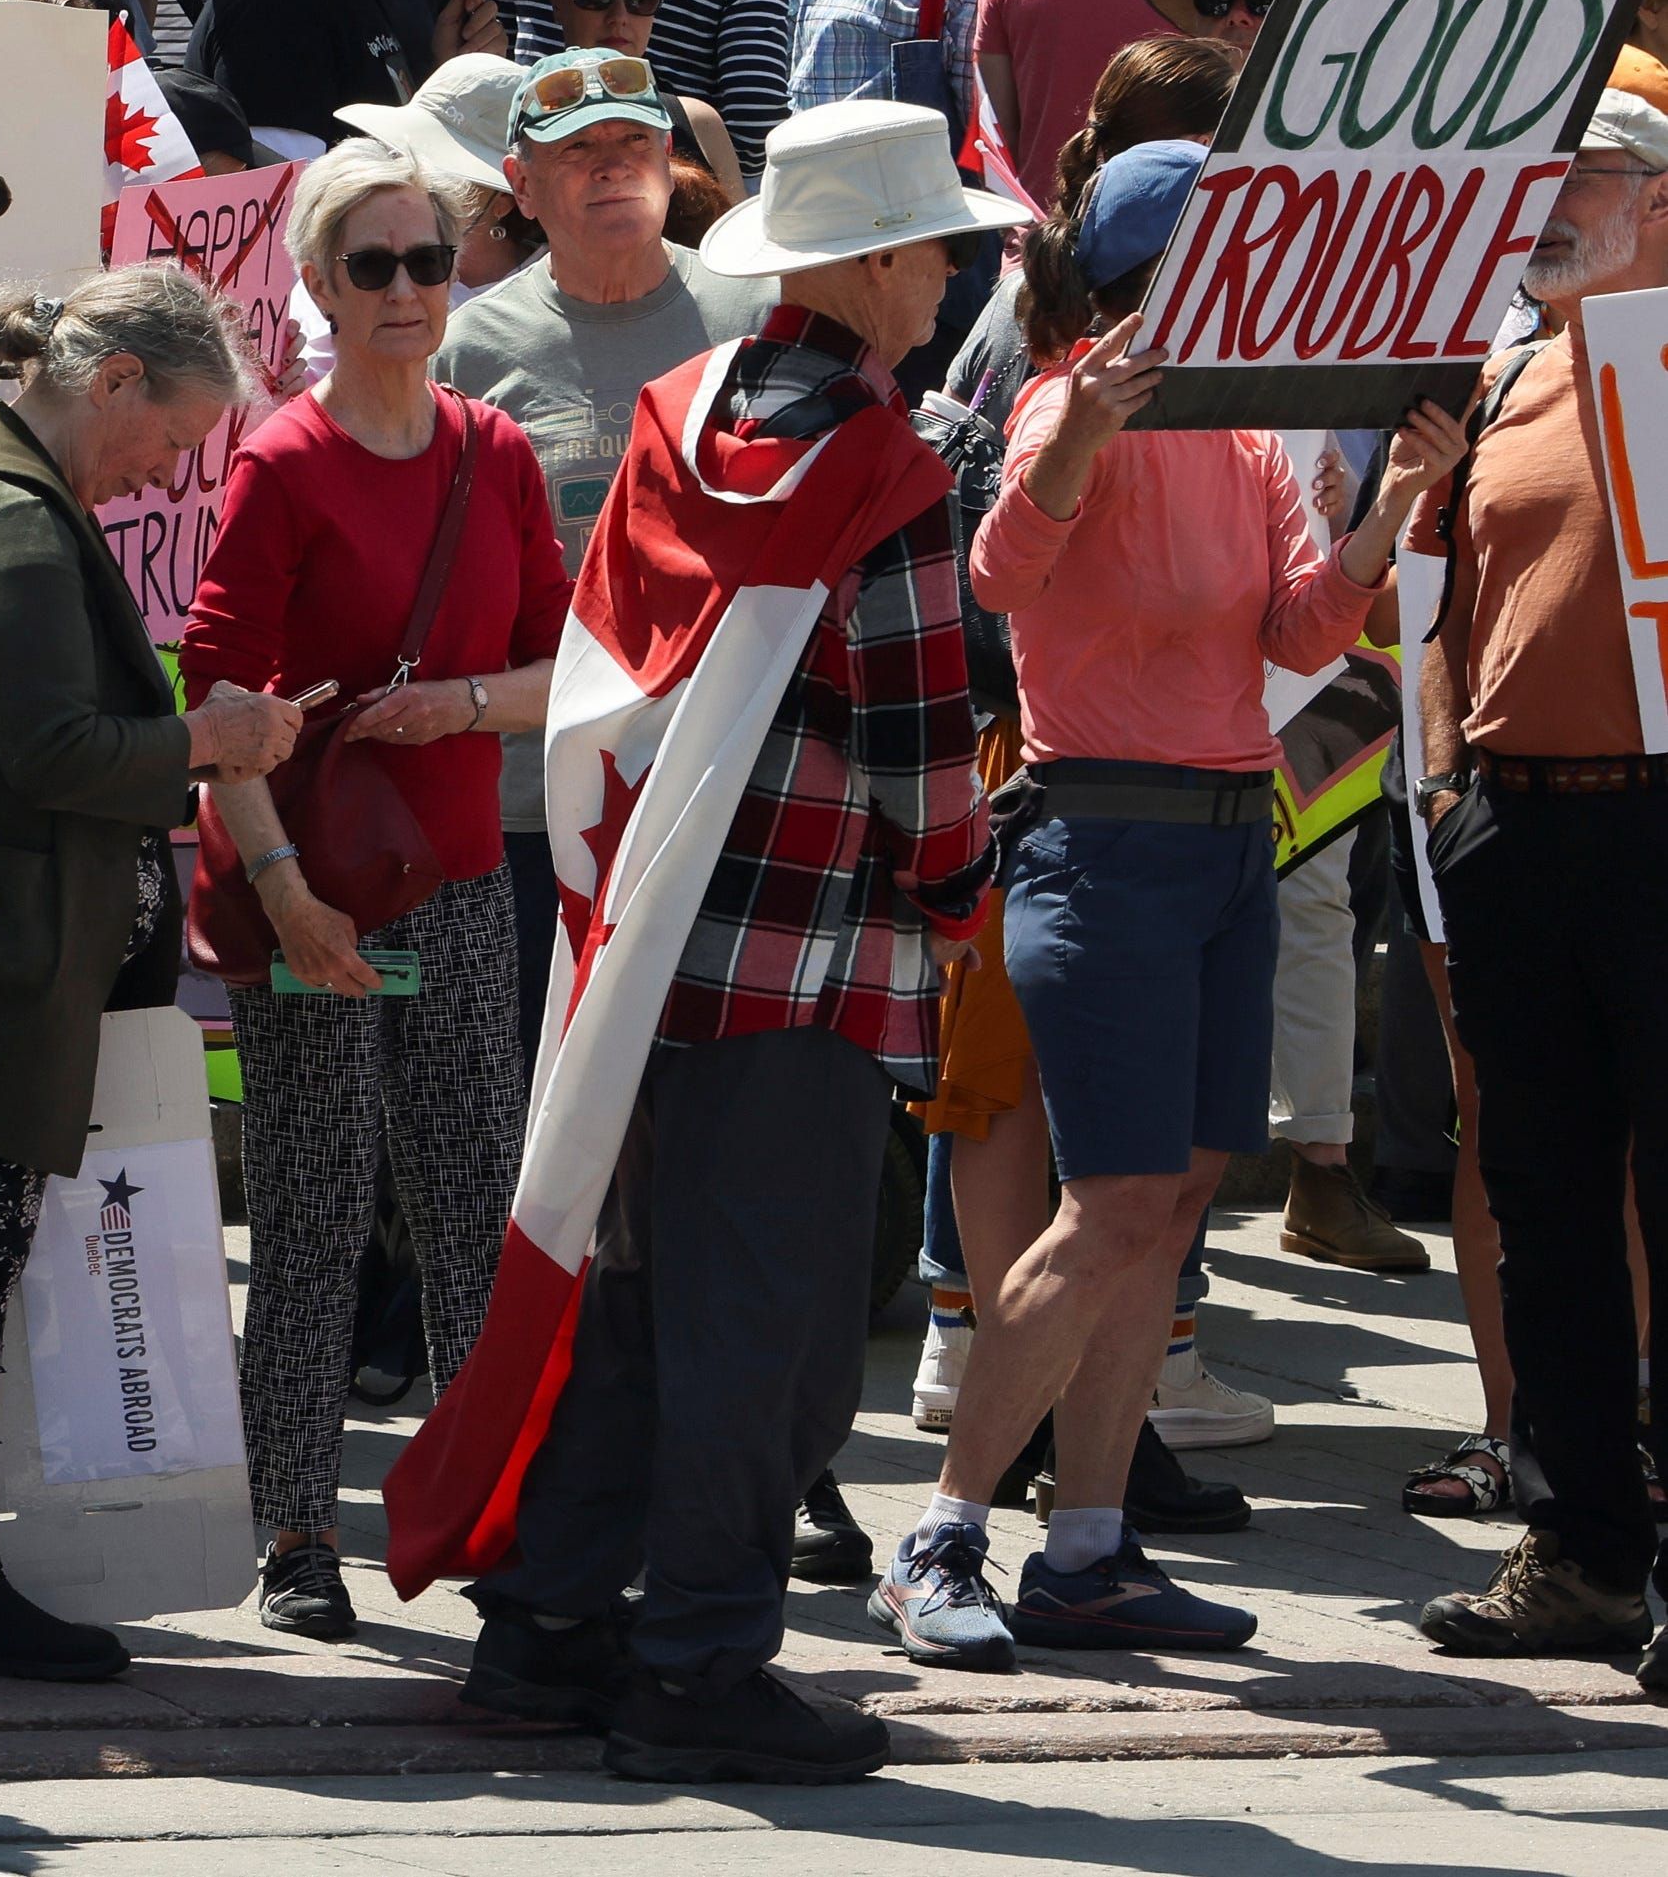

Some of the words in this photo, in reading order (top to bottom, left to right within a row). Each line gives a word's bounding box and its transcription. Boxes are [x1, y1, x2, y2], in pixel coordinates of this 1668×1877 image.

[1151, 160, 1571, 364] TROUBLE
[84, 1234, 102, 1276] Quebec
[102, 1230, 147, 1362] DEMOCRATS
[119, 1366, 158, 1454] ABROAD
